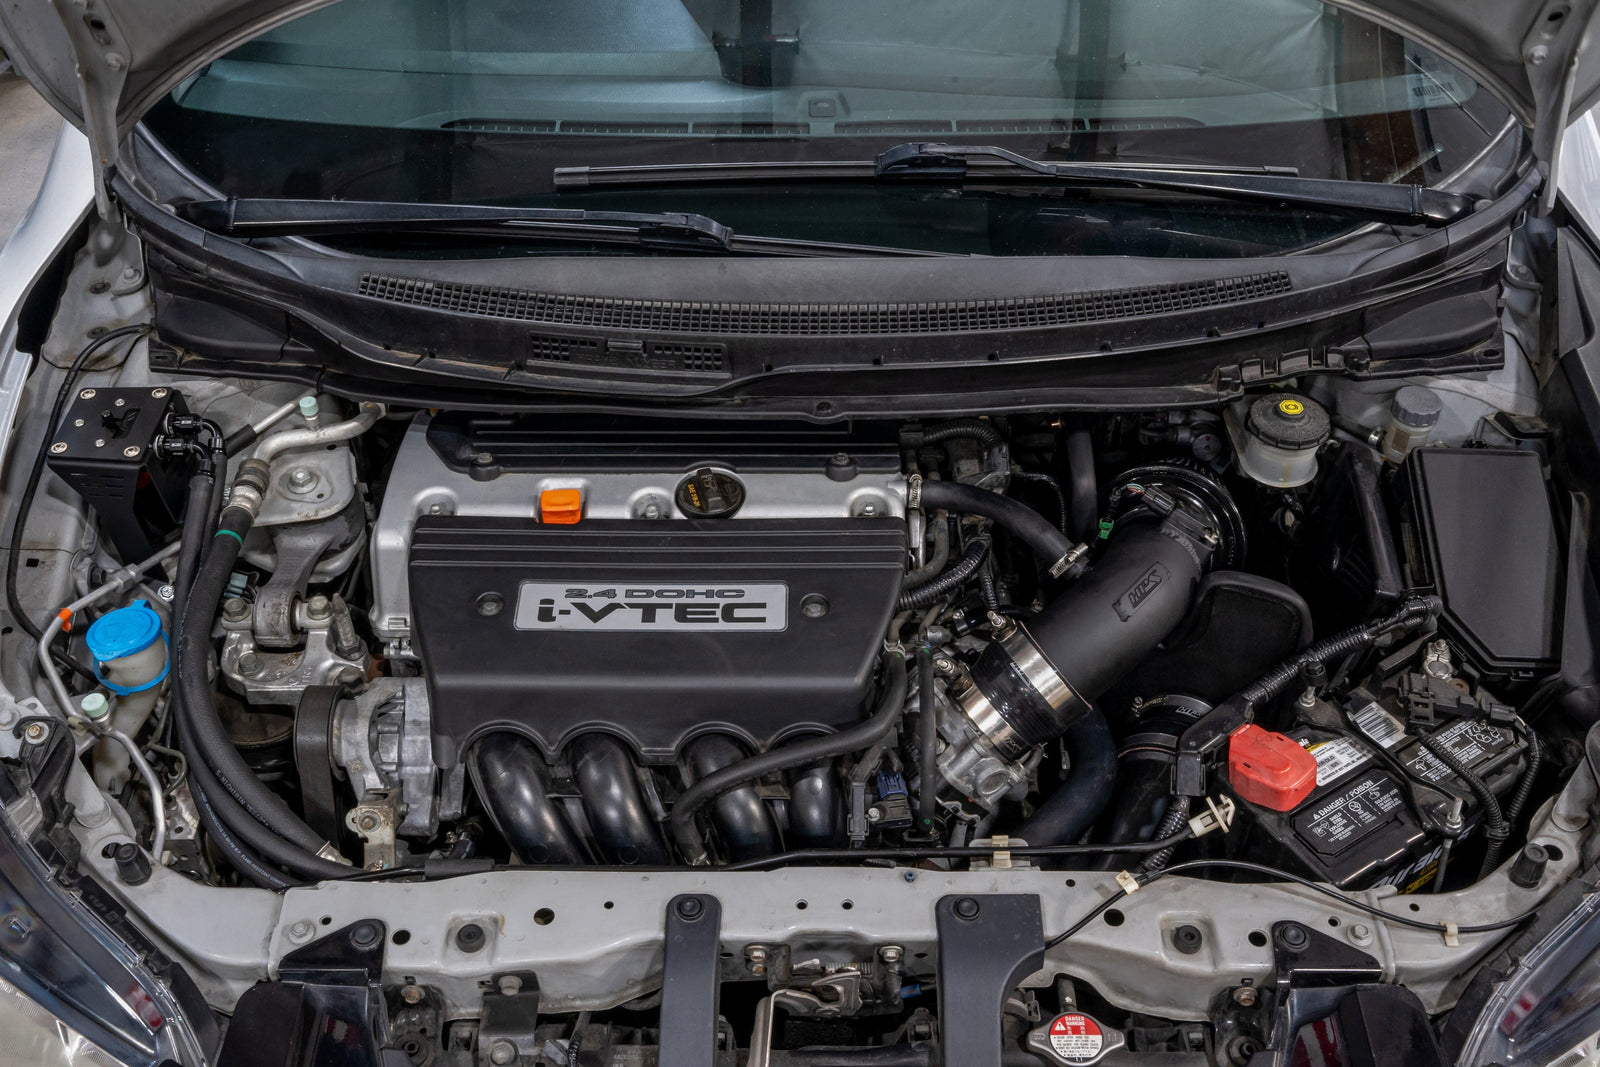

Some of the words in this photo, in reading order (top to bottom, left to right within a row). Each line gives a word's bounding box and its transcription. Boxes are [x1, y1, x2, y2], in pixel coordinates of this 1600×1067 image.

[564, 588, 617, 599] 2.4
[624, 588, 745, 599] DOHC
[1128, 571, 1163, 609] HPS
[537, 598, 767, 624] i-VTEC
[1318, 797, 1346, 816] DANGER
[1348, 779, 1375, 798] POISON
